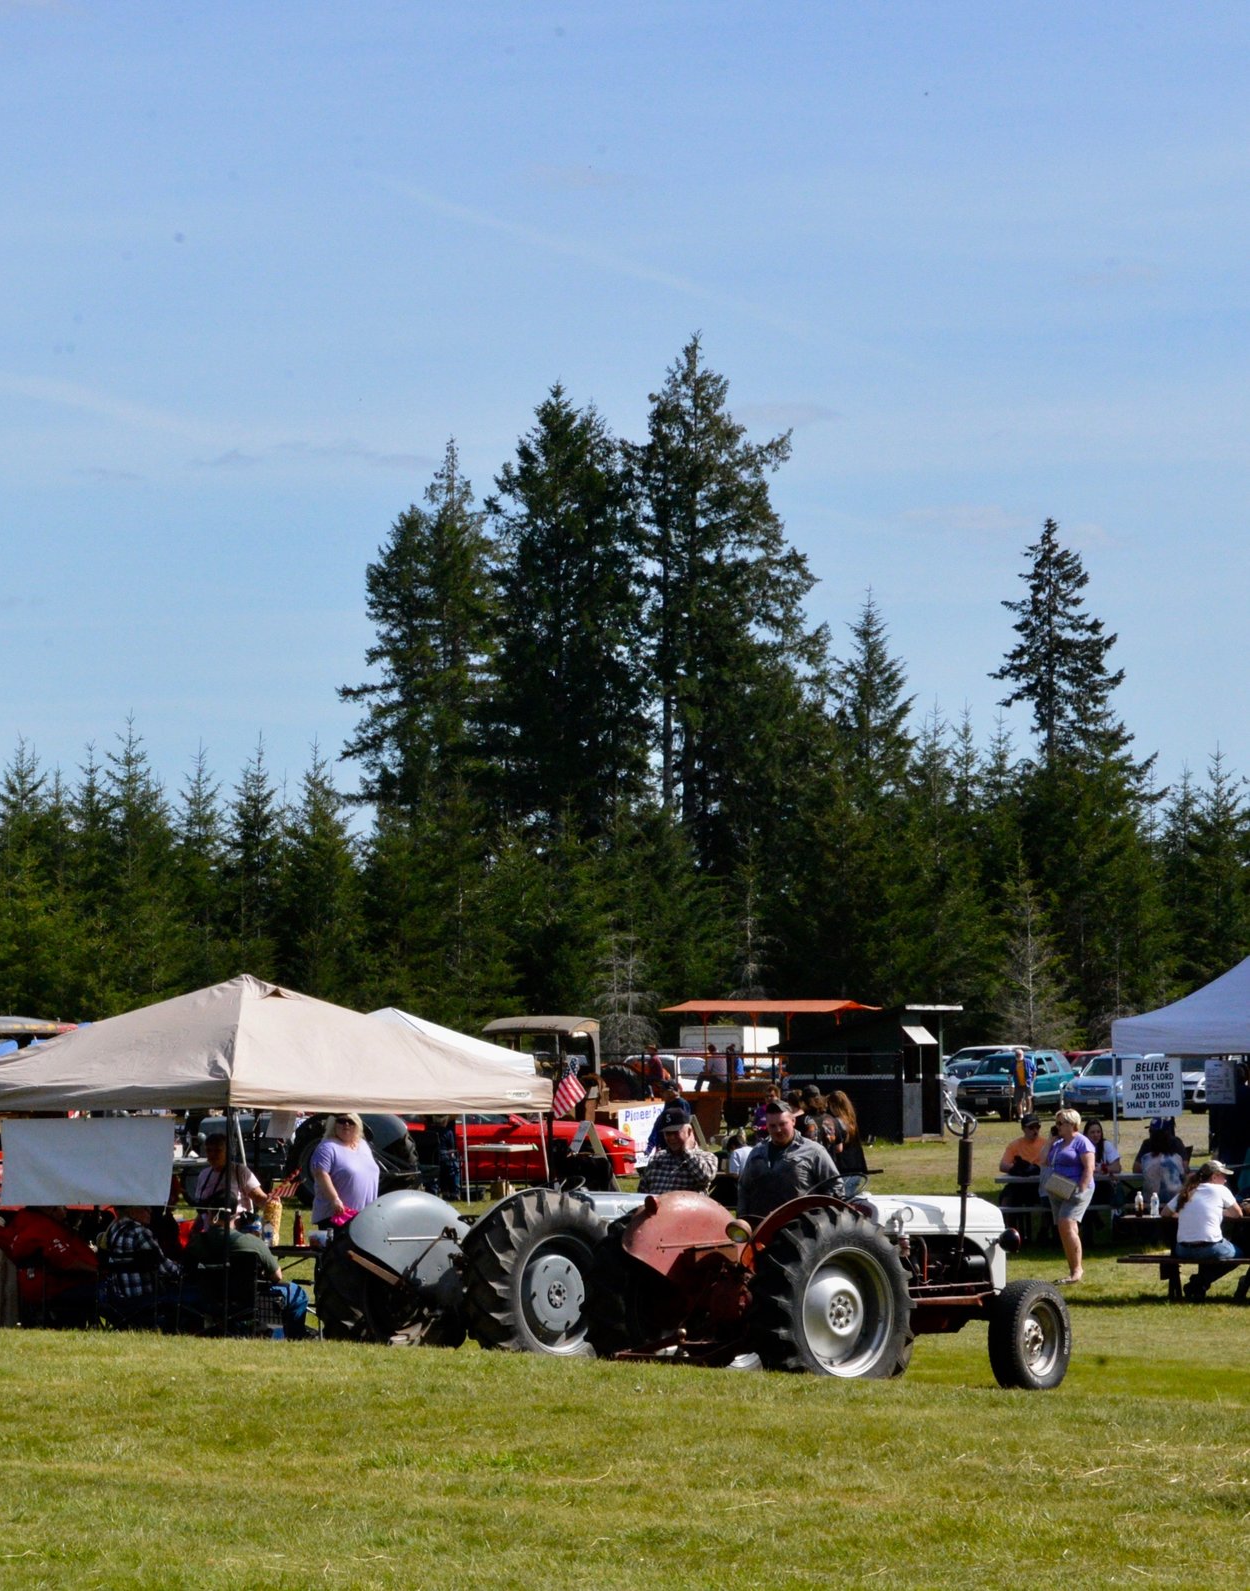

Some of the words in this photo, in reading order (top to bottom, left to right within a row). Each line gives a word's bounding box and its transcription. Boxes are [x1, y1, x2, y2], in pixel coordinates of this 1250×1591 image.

[1135, 1062, 1169, 1072] BELIEVE
[1130, 1074, 1141, 1082] ON
[1142, 1073, 1155, 1081] THE
[1130, 1083, 1150, 1091] JESUS
[1151, 1082, 1174, 1090] CHRIST
[1135, 1092, 1150, 1100] AND
[1151, 1091, 1171, 1099] THOU
[1126, 1101, 1147, 1109] SHALT
[1158, 1100, 1180, 1108] SAVED
